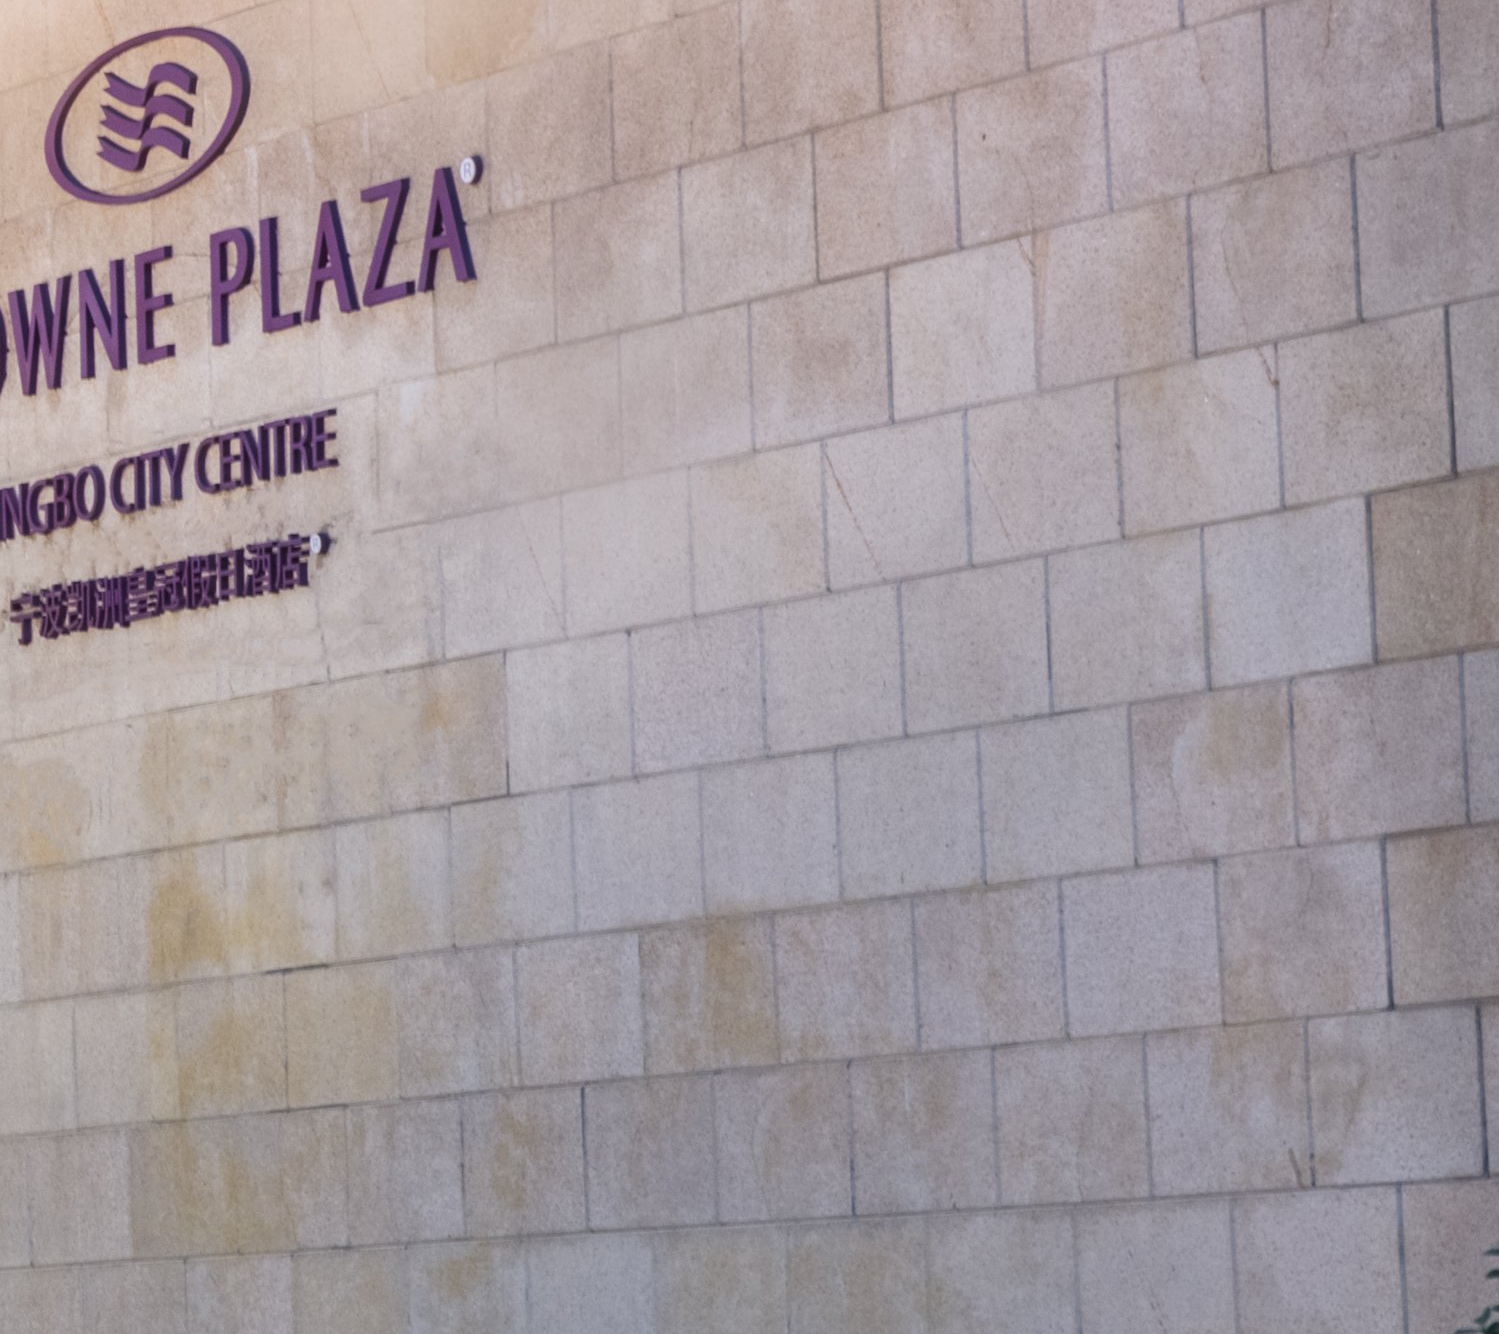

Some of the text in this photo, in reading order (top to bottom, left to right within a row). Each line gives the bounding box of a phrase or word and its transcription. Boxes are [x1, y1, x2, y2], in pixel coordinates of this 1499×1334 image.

[210, 166, 478, 346] PLAZA
[110, 442, 191, 516] CITY
[194, 407, 340, 496] CENTRE
